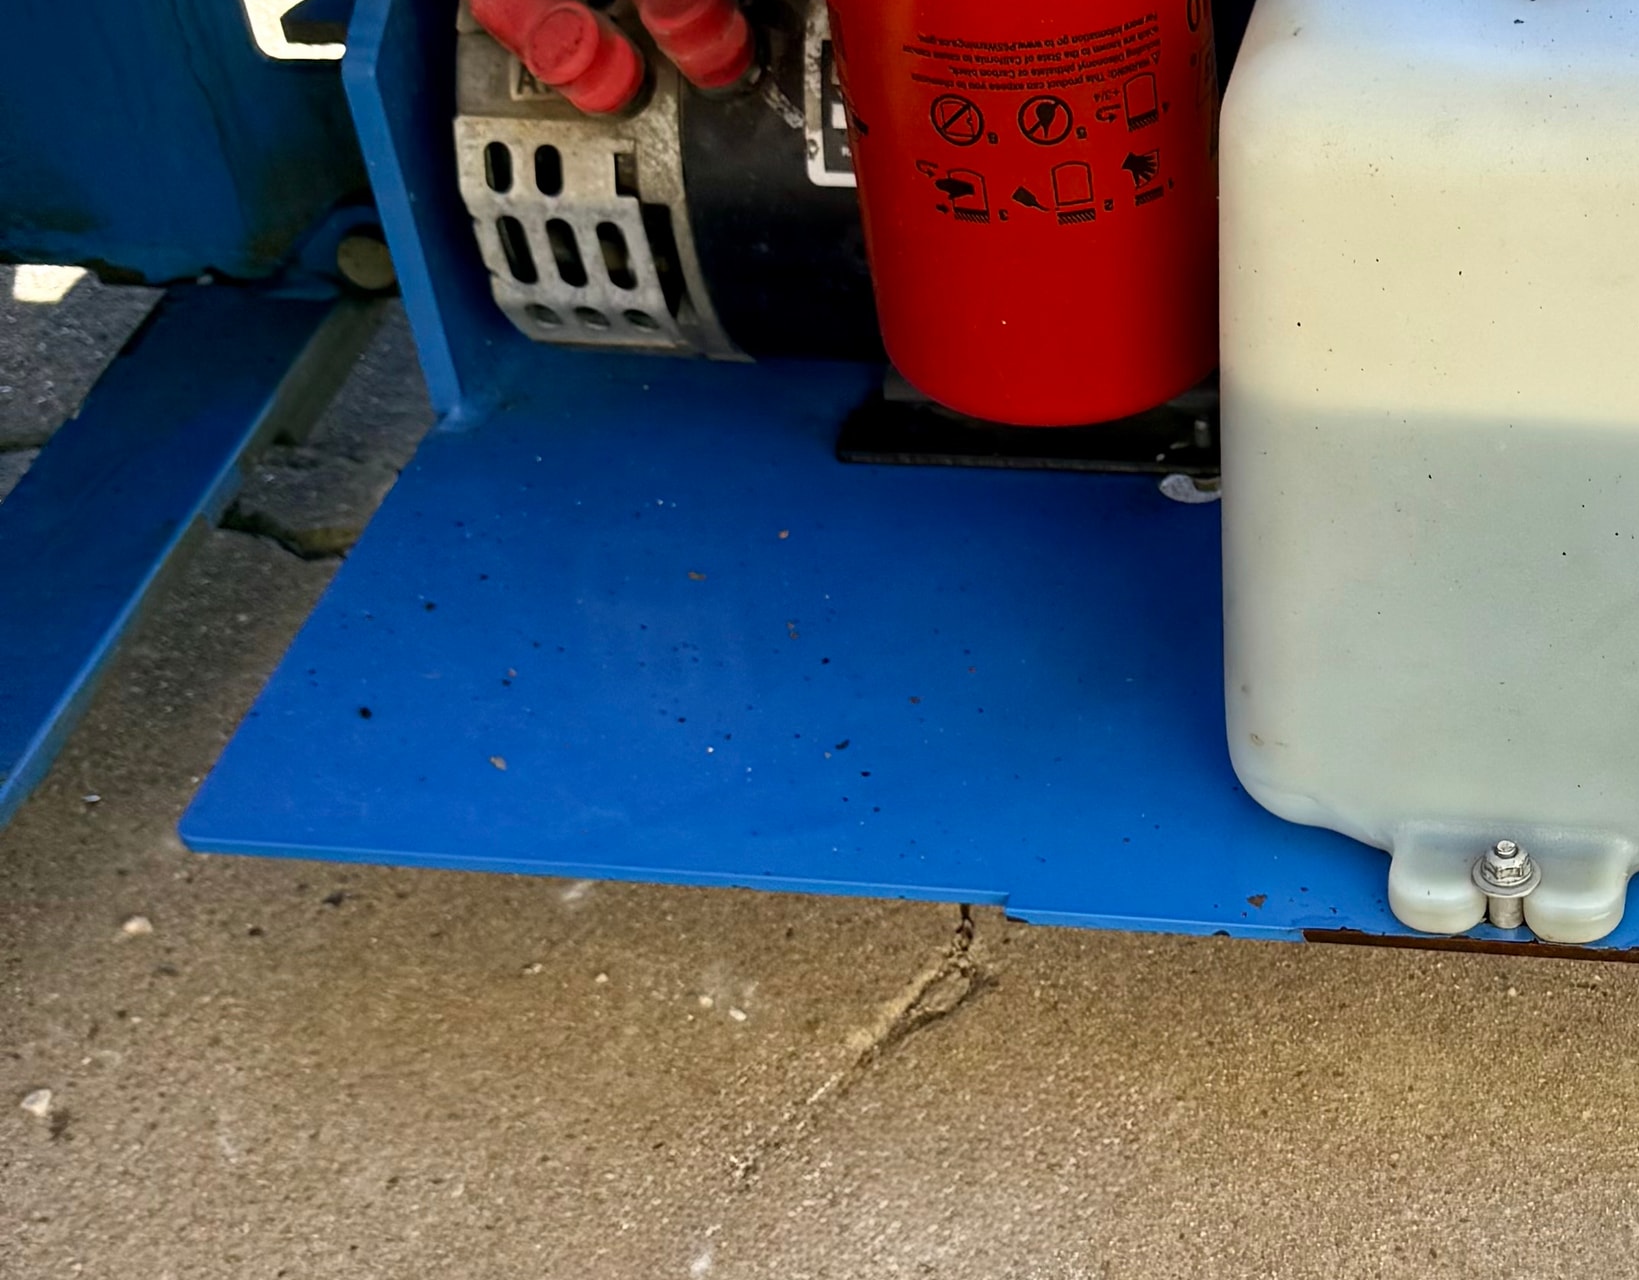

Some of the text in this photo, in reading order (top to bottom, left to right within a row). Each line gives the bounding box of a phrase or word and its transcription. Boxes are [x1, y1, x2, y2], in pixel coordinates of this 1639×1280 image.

[1044, 40, 1054, 48] to
[1057, 35, 1069, 46] go
[1064, 50, 1079, 60] the
[1081, 48, 1090, 56] to
[962, 55, 972, 64] to
[975, 55, 1022, 65] California
[1024, 55, 1034, 65] of
[1036, 53, 1062, 63] State
[979, 70, 1015, 78] Carbon
[1086, 72, 1104, 83] This
[956, 81, 966, 90] to
[968, 81, 986, 90] you
[989, 82, 1024, 90] expose
[1047, 76, 1084, 89] product
